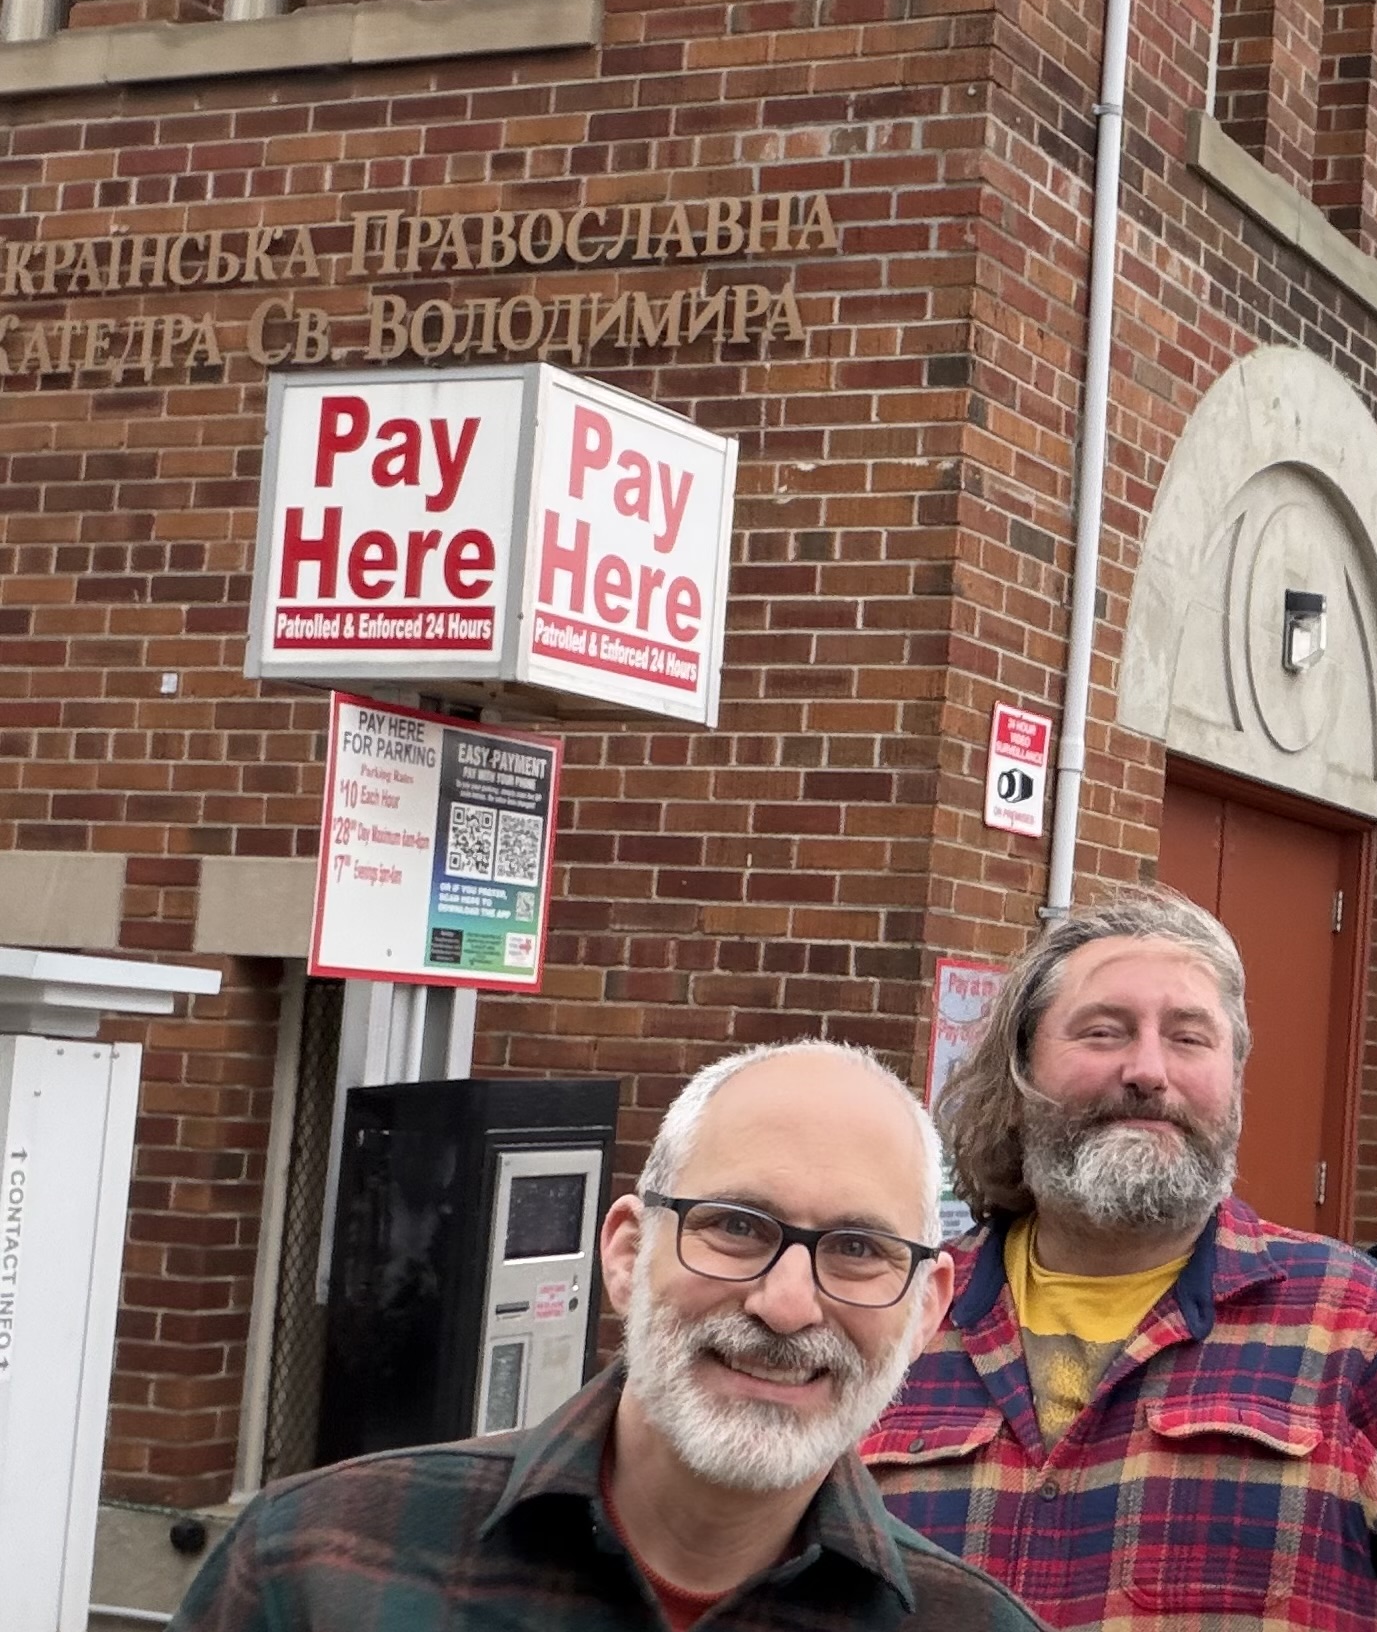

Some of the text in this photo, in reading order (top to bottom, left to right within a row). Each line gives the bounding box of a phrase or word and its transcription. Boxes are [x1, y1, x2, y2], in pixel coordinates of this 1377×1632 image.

[0, 193, 840, 295] КРАЇНСЬКА ПРАВОСЛАВНА
[364, 281, 809, 366] ВОЛОДИМИРА
[314, 396, 481, 512] Pay
[568, 404, 694, 554] Pay
[278, 506, 495, 600] Here
[538, 509, 702, 643] Here
[276, 613, 492, 639] Patrolled & Enforced 24 Hours
[534, 617, 698, 682] Patrolled & Enforced 24 Hours
[343, 731, 436, 768] FOR PARKING
[358, 710, 425, 743] PAY HERE
[360, 763, 392, 783] Parking
[360, 785, 380, 806] Each
[381, 789, 400, 809] Hour
[0, 1169, 25, 1349] CONTACT INFO
